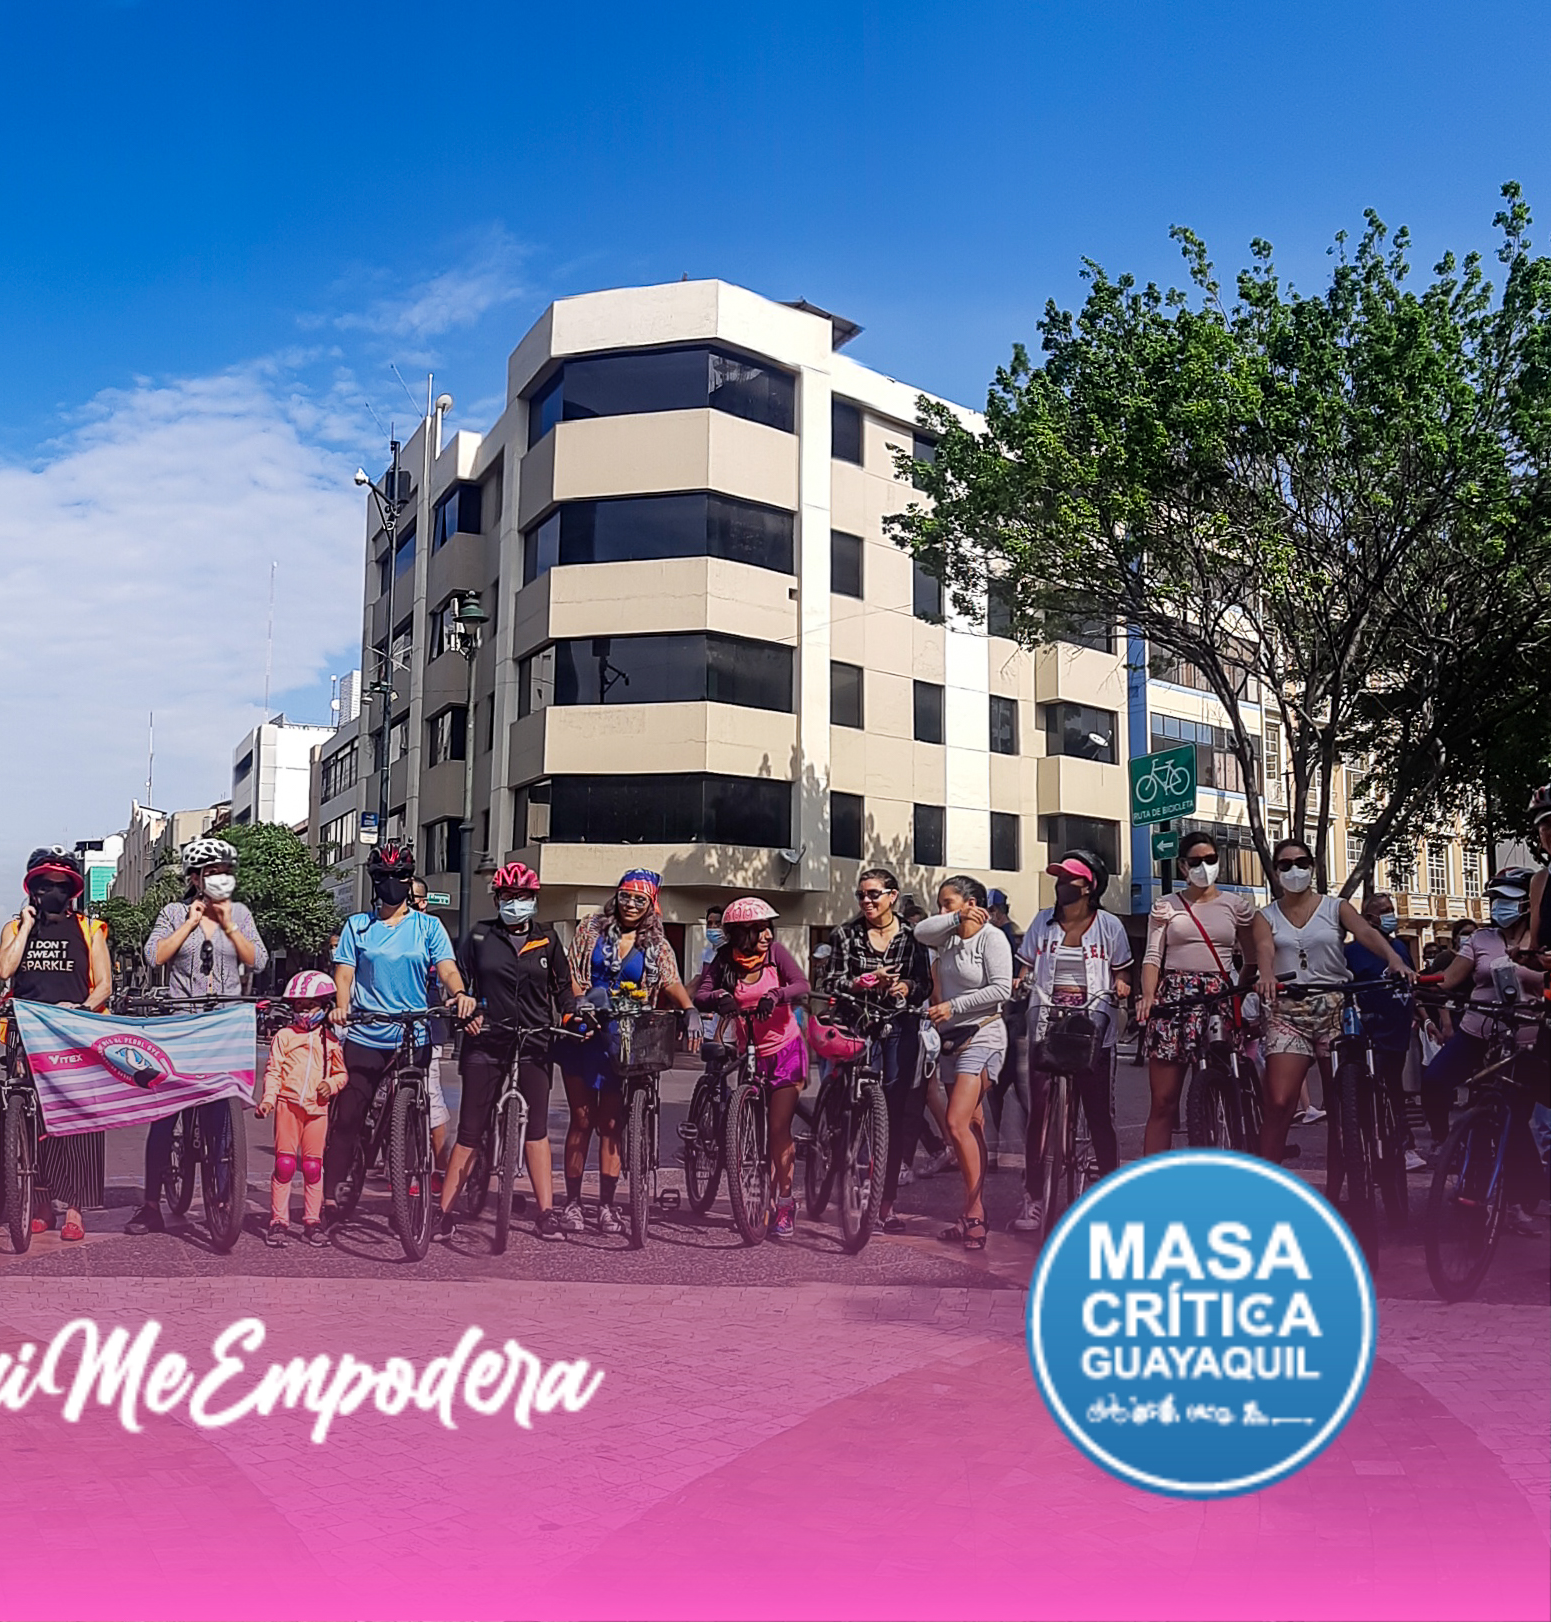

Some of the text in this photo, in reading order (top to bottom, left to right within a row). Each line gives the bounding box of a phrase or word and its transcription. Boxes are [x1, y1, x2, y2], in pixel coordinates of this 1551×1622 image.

[1133, 811, 1151, 820] RUTA
[1151, 807, 1162, 817] DE
[30, 941, 34, 949] I
[27, 950, 67, 959] SWEAT I
[21, 960, 75, 972] SPARKLE
